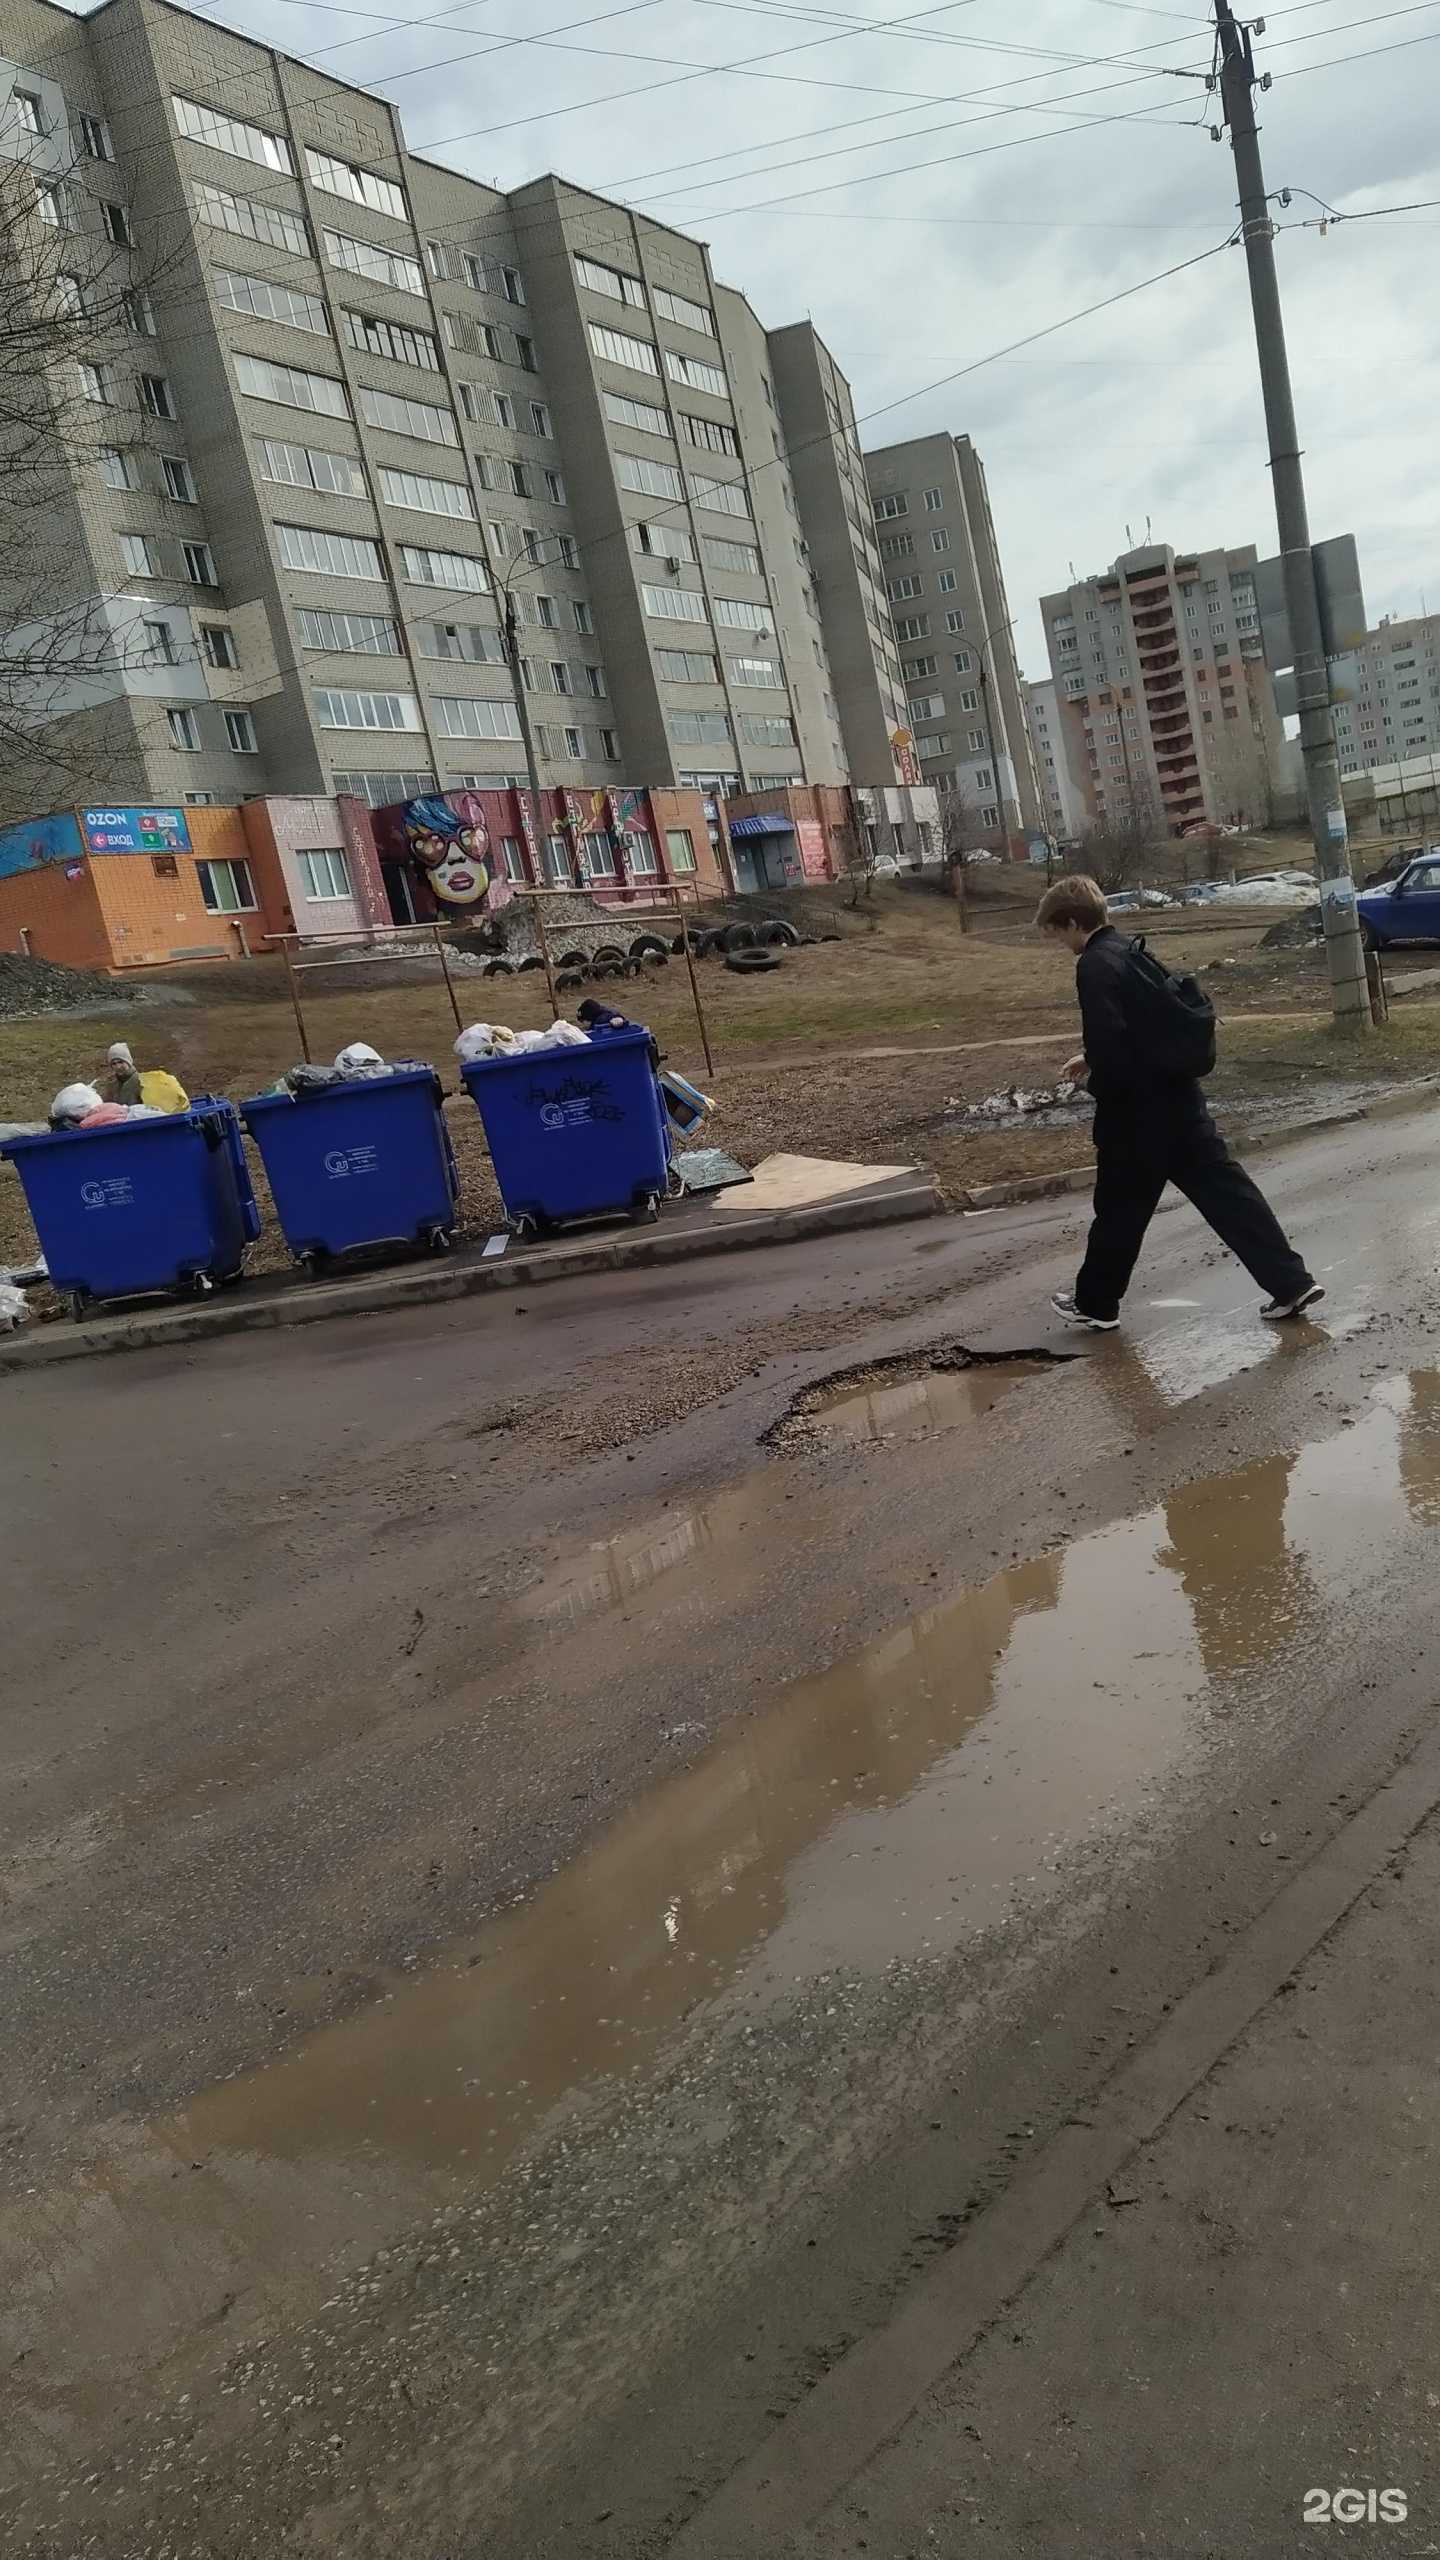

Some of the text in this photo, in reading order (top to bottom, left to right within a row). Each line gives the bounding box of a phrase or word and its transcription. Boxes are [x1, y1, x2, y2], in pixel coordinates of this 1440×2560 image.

[87, 813, 128, 825] OZON
[107, 834, 135, 846] ВХОД
[608, 794, 635, 887] КРАОТЫ
